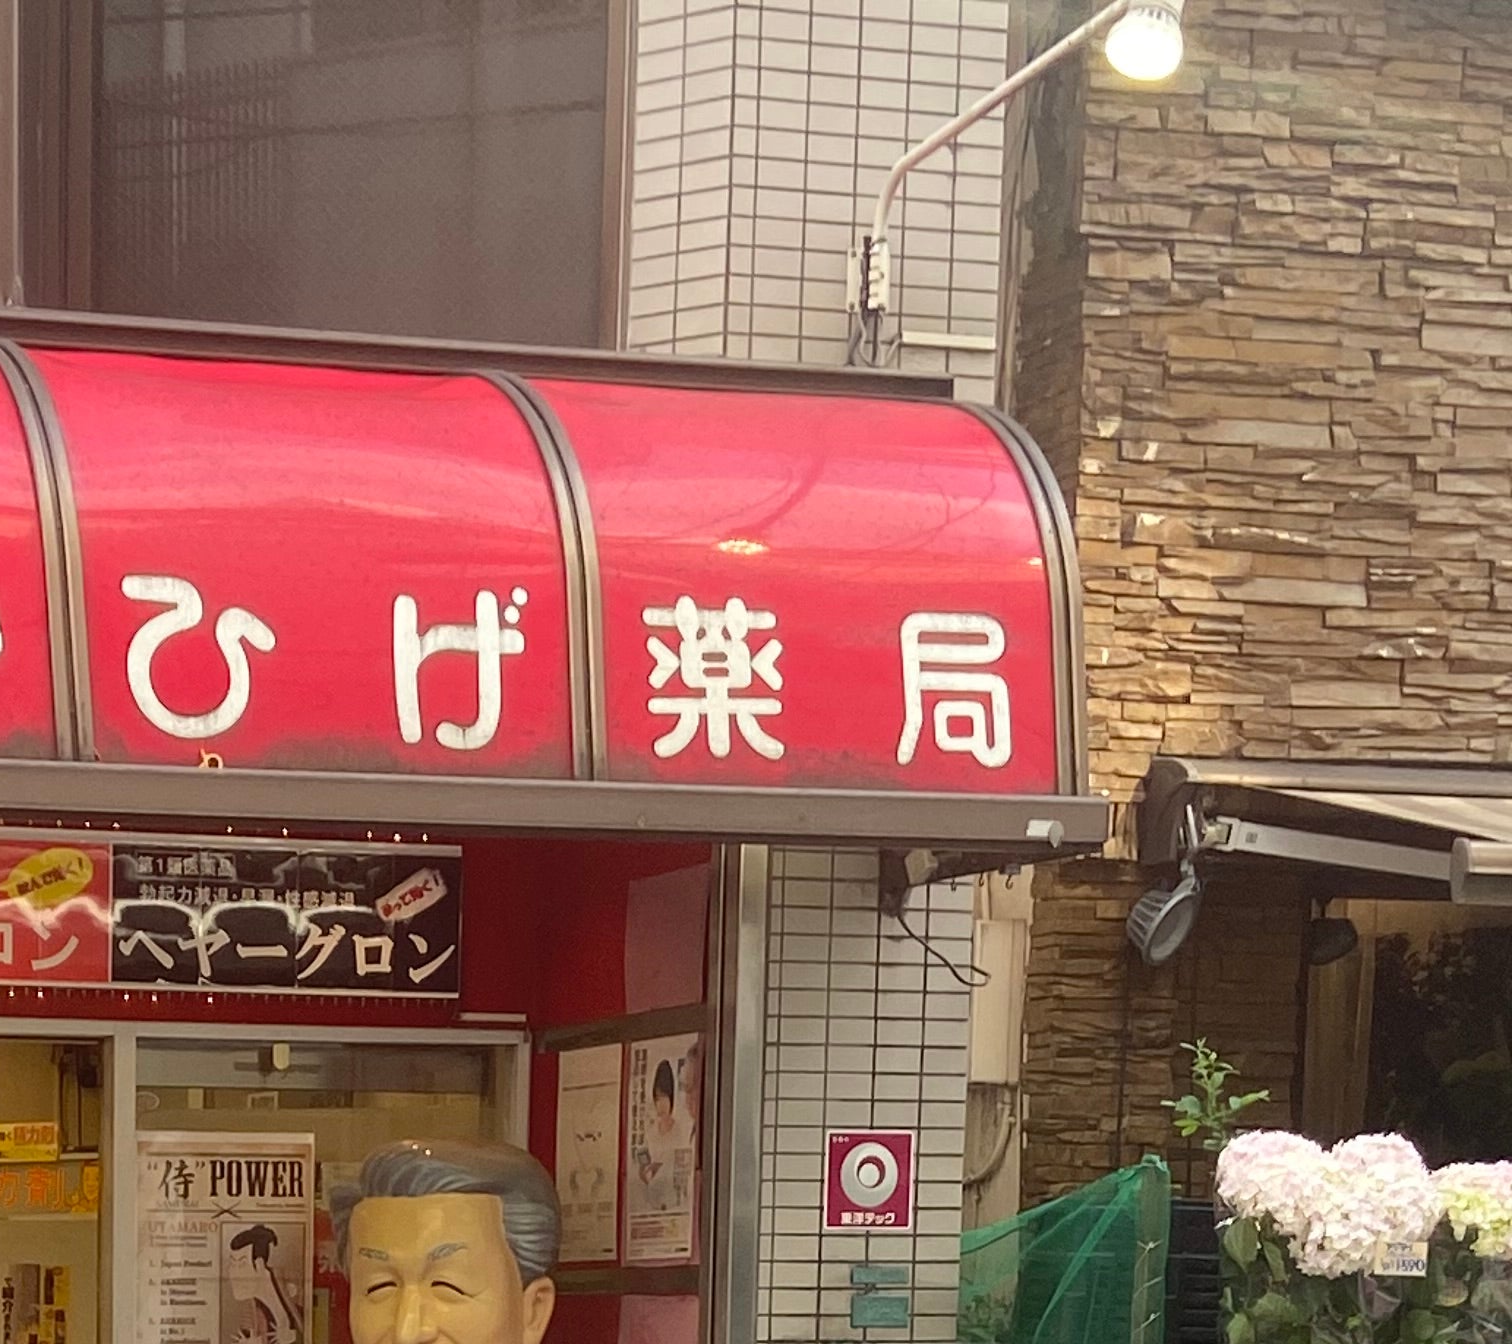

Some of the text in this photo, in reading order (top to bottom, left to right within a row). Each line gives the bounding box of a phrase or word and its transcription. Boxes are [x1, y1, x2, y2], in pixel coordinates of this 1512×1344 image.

[119, 923, 456, 985] ヘヤーグロン
[210, 1160, 304, 1198] POWER
[147, 1220, 219, 1234] UTAMARO
[840, 1211, 896, 1226] 東洋テック
